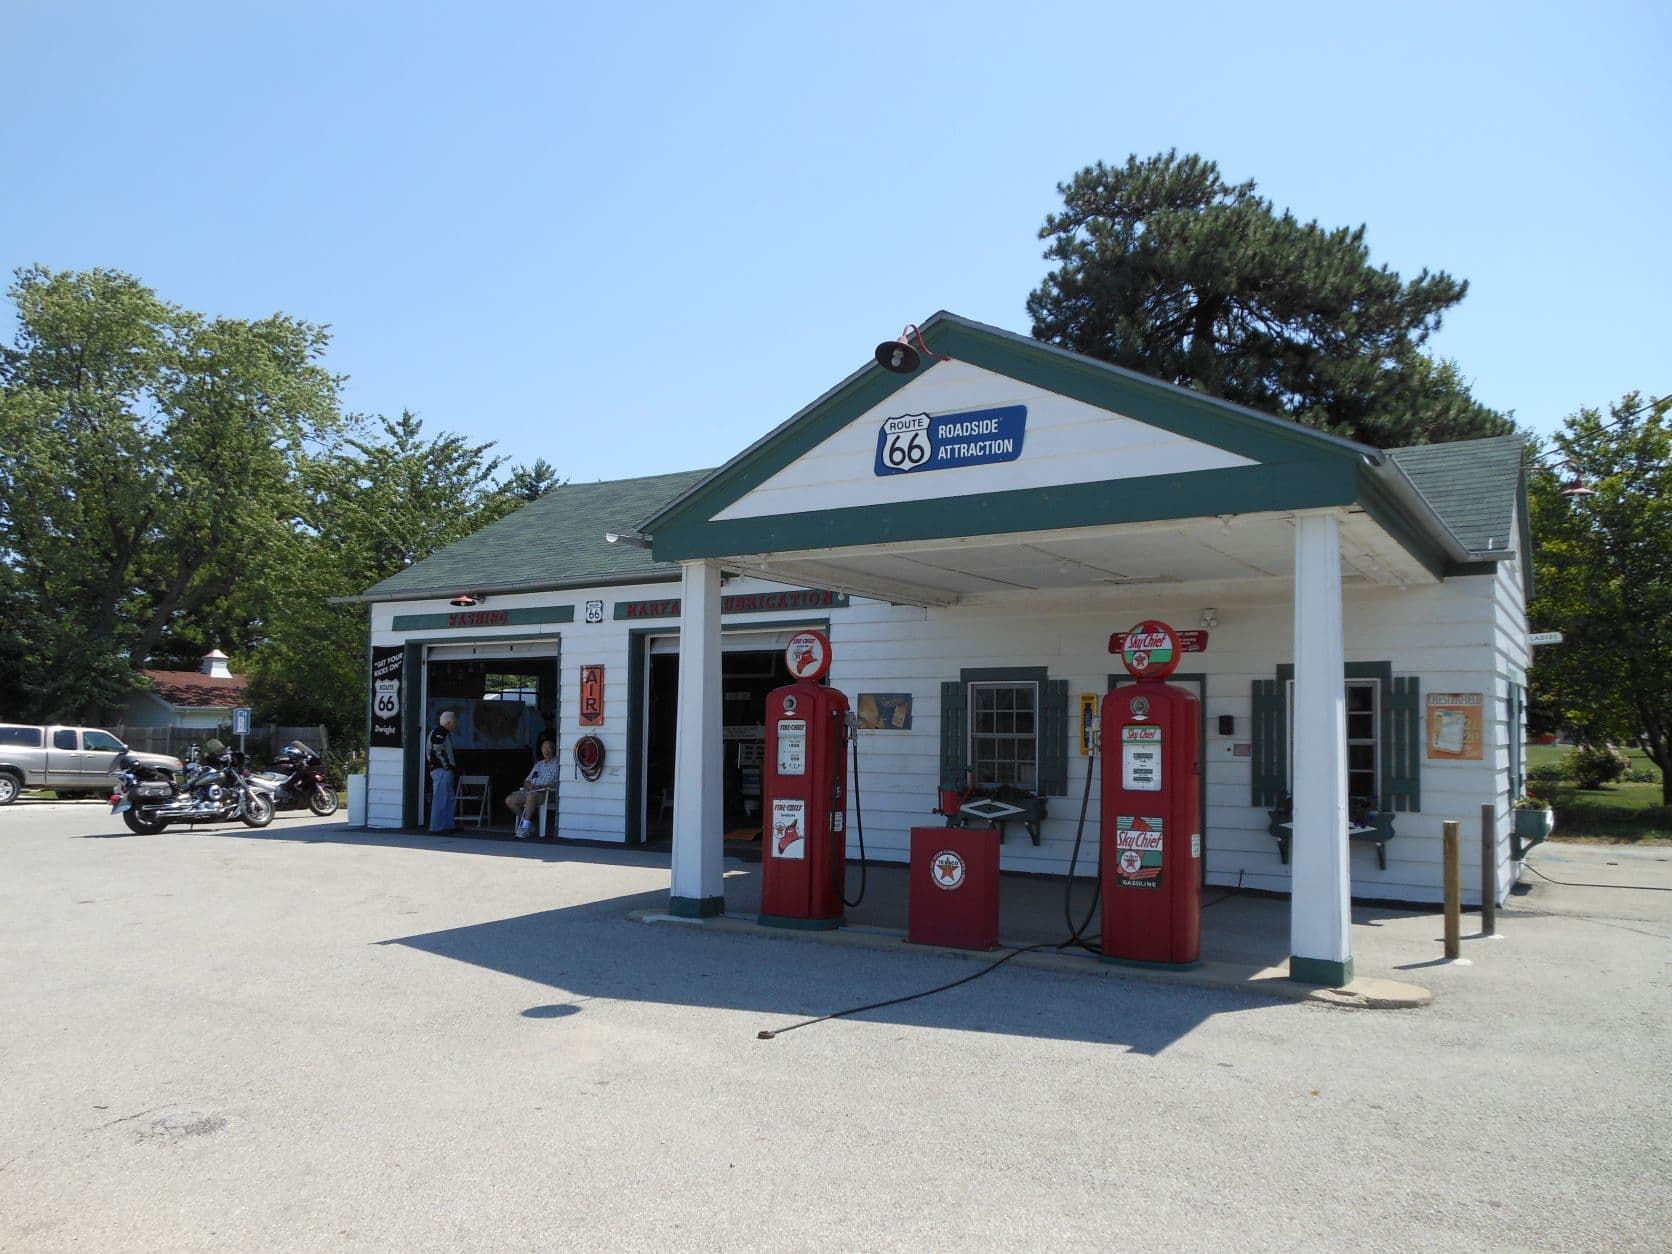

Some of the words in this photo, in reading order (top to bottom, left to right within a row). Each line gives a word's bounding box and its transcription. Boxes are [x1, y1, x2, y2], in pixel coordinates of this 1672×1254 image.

[890, 418, 924, 430] ROUTE
[938, 419, 998, 439] ROADSIDE
[889, 432, 925, 466] 66
[938, 439, 1013, 460] ATTRACTION
[724, 591, 833, 611] UBRICATION
[448, 611, 508, 627] WASHING
[588, 609, 600, 620] 66
[1129, 635, 1143, 651] Sky
[1143, 634, 1167, 648] Chief
[586, 670, 598, 711] AIR
[378, 696, 395, 712] 66
[375, 725, 396, 735] Dwight
[1118, 831, 1135, 849] Sky
[1135, 832, 1162, 849] Chief
[1122, 880, 1157, 888] GASOLINE
